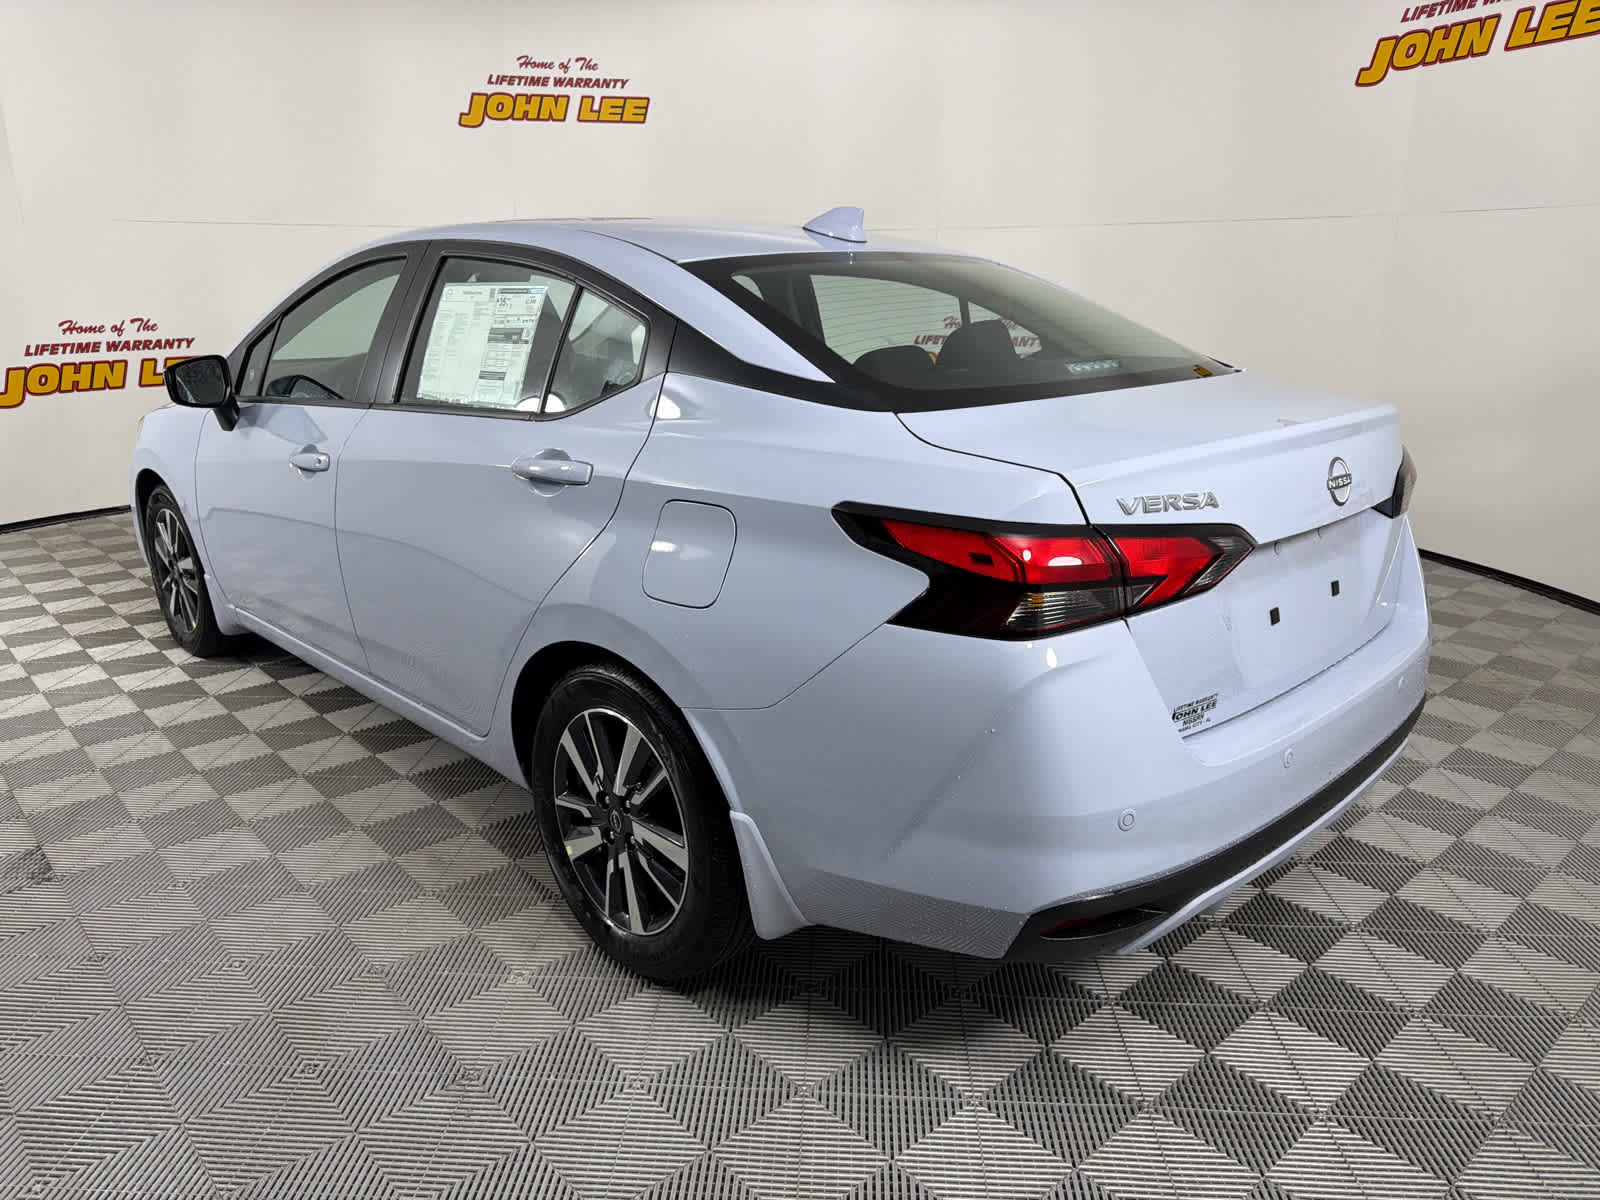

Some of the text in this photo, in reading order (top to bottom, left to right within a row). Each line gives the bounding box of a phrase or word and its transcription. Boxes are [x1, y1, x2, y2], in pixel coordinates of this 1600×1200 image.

[1355, 0, 1600, 87] JOHN LEE
[516, 55, 599, 74] Home of The
[487, 74, 630, 89] LIFETIME WARRANTY
[458, 92, 650, 128] JOHN LEE
[58, 317, 158, 337] Home of The
[24, 337, 195, 357] LIFETIME WARRANTY
[913, 335, 948, 345] LIFET
[0, 359, 128, 409] JOHN
[1116, 489, 1220, 516] VERSA
